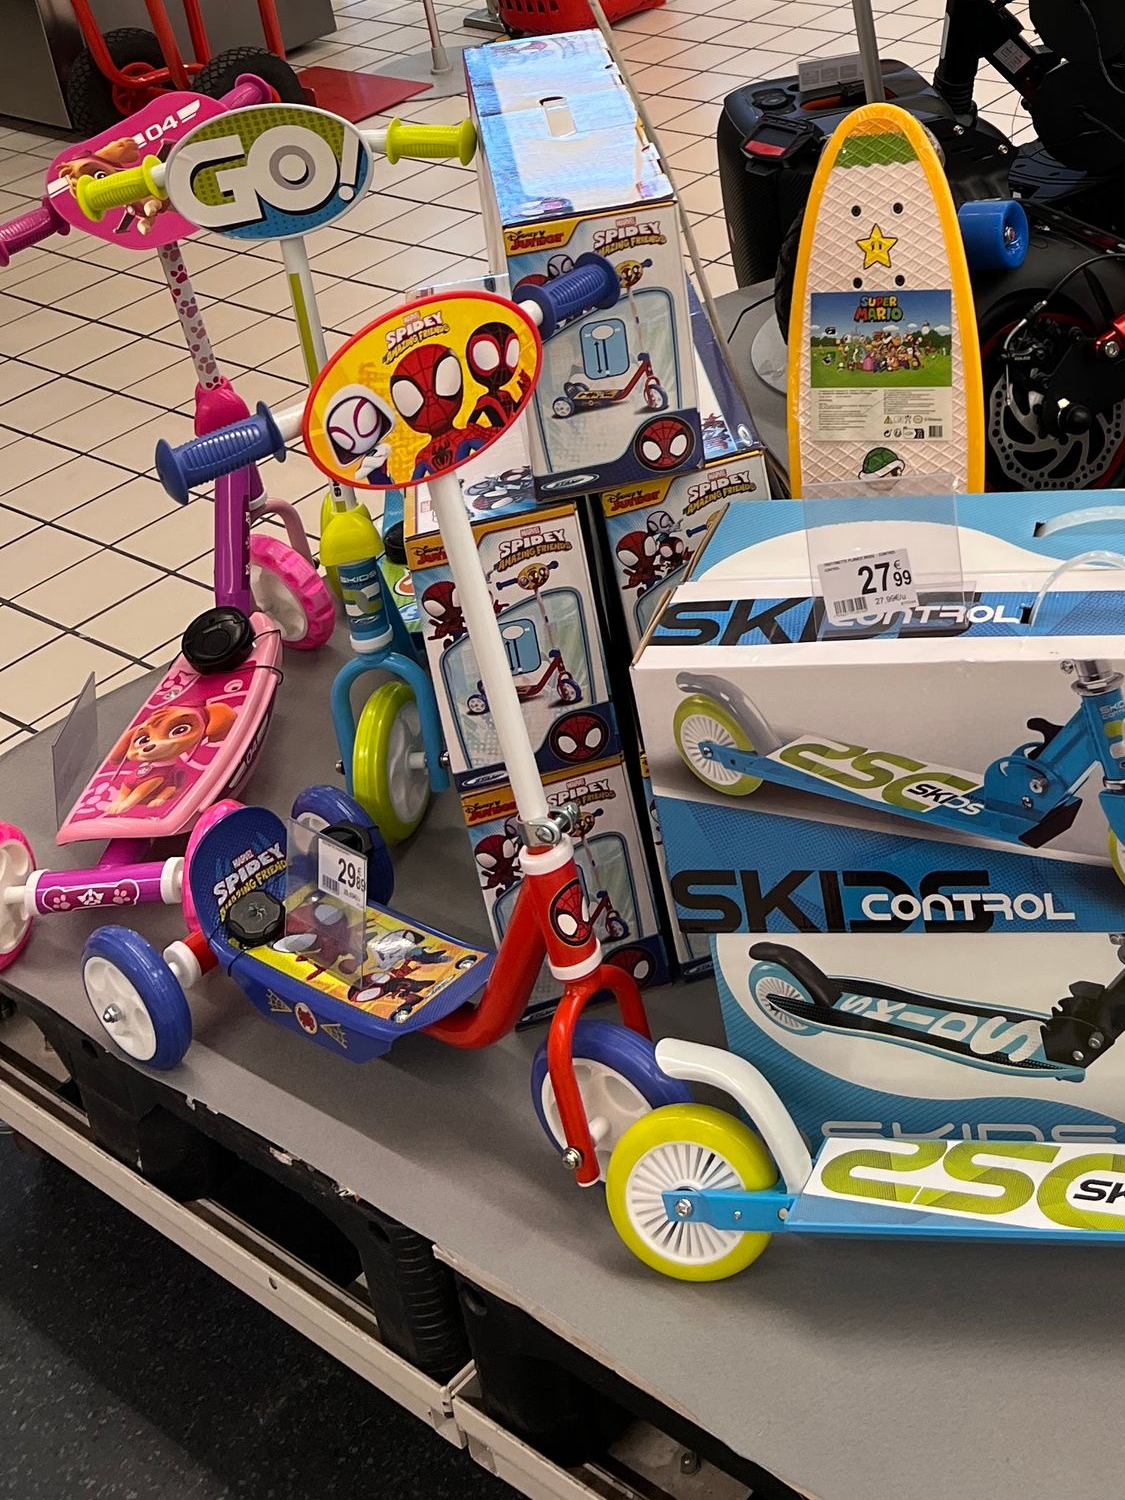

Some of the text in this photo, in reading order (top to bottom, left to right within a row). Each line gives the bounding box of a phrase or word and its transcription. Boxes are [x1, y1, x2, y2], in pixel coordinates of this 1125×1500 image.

[165, 125, 360, 229] GO!
[593, 220, 662, 250] SPIDEY
[853, 306, 904, 324] MARIO
[860, 295, 898, 310] SUPER
[385, 310, 443, 351] SPIDEY
[687, 470, 751, 501] SPIDEY
[499, 529, 566, 558] SPIDEY
[546, 778, 611, 807] SPIDEY
[213, 842, 287, 907] SPIDEY
[670, 869, 993, 934] SKIDS
[861, 892, 1076, 921] CONTROL
